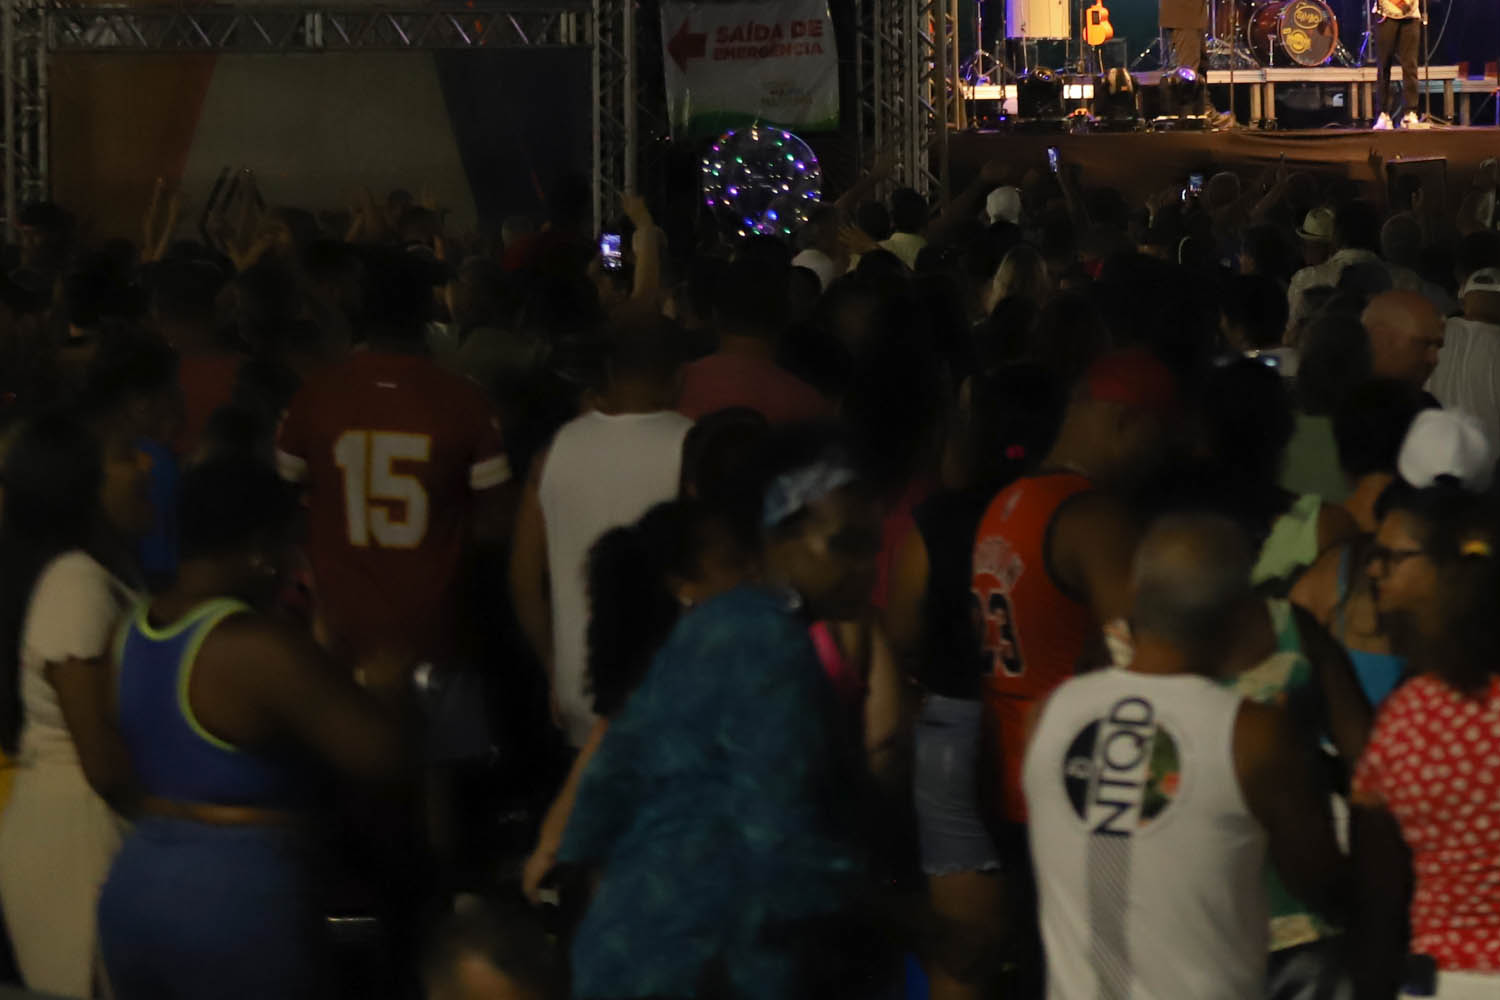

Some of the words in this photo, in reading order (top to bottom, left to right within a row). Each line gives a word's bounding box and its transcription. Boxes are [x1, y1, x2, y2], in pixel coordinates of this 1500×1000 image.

[715, 21, 783, 43] SAÍDA
[791, 19, 824, 38] DE
[331, 428, 432, 550] 15
